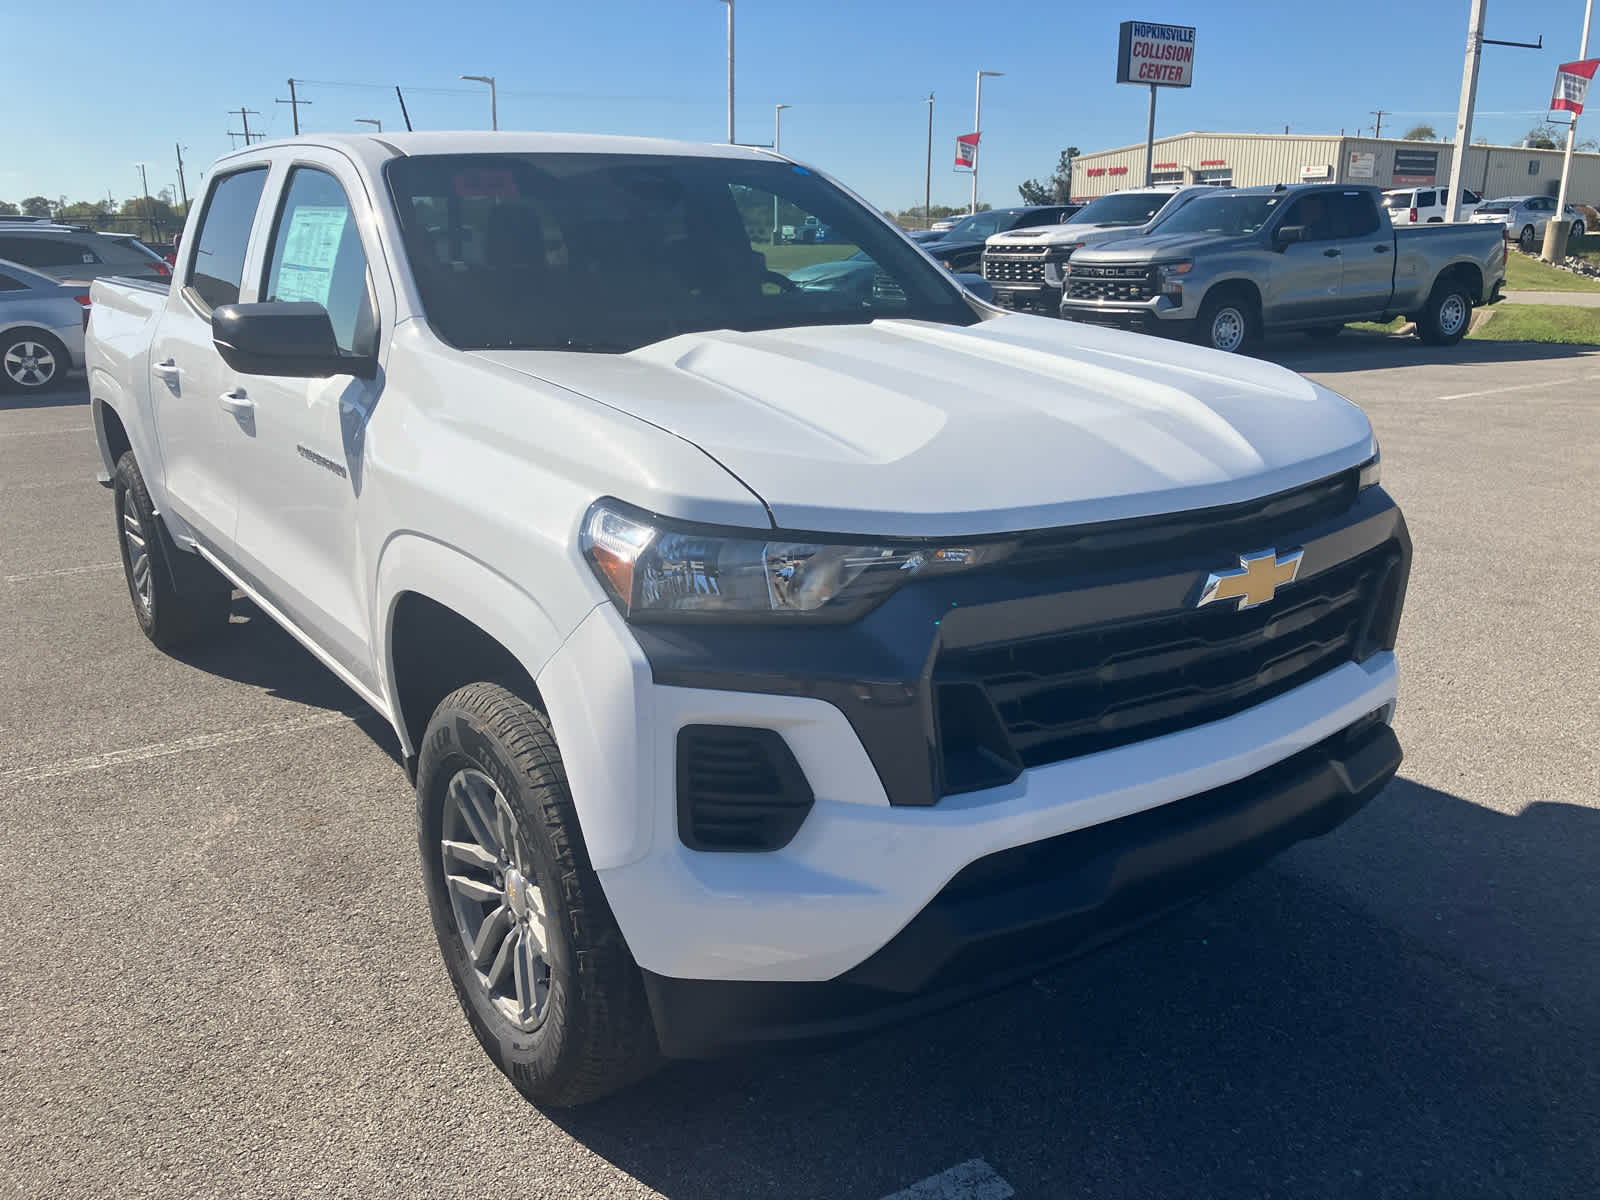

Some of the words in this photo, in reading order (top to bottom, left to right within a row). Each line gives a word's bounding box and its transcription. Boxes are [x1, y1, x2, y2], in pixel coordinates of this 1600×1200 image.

[1134, 24, 1193, 43] HOPKINSVILLE
[1133, 41, 1193, 63] COLLISION
[1138, 62, 1184, 82] CENTER
